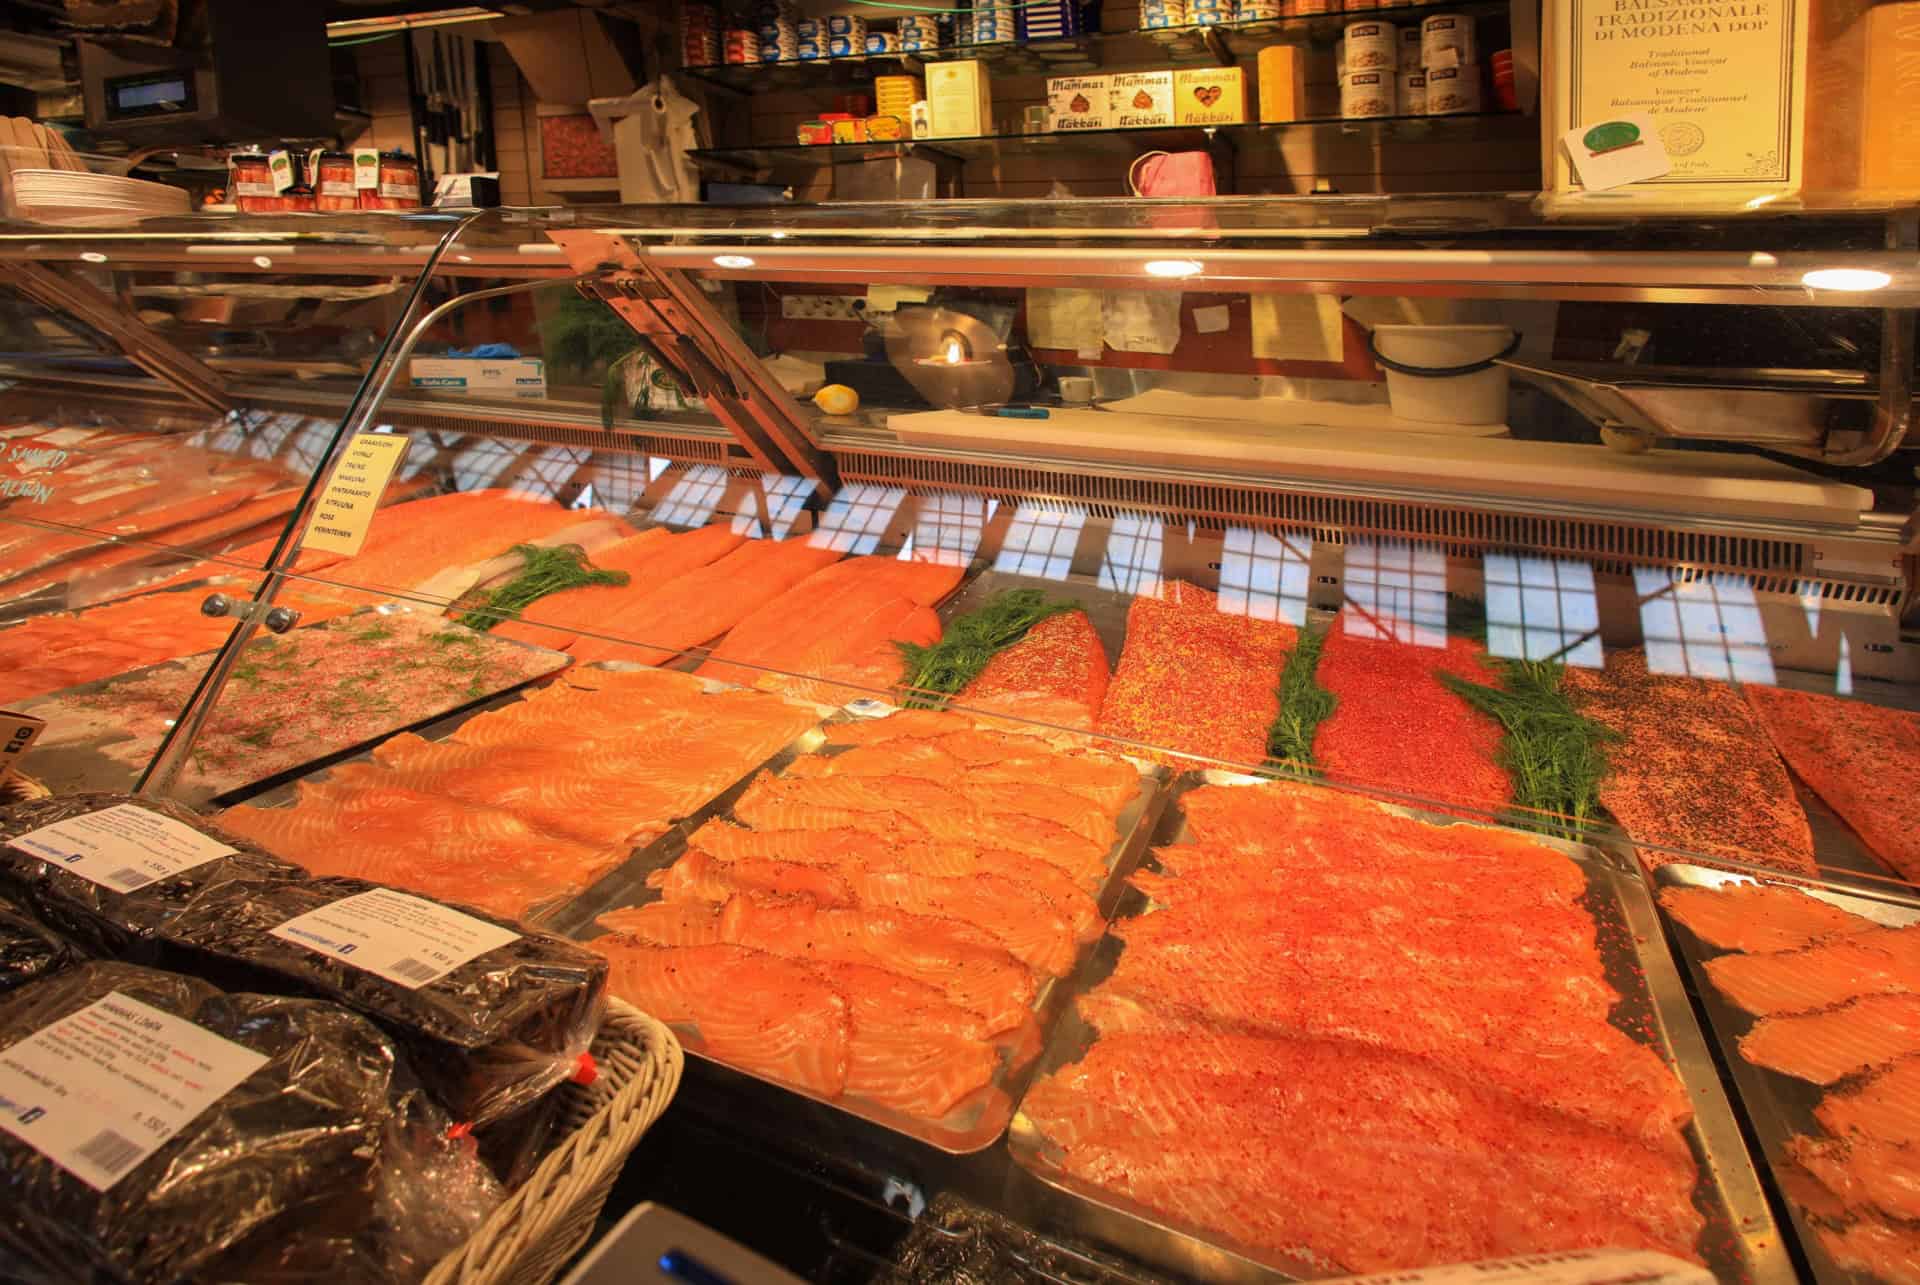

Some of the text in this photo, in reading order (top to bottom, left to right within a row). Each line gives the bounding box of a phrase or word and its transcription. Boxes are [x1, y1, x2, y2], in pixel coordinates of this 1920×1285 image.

[1595, 4, 1769, 27] TRADIZIONALE
[1595, 20, 1769, 41] DI MODENA DOP
